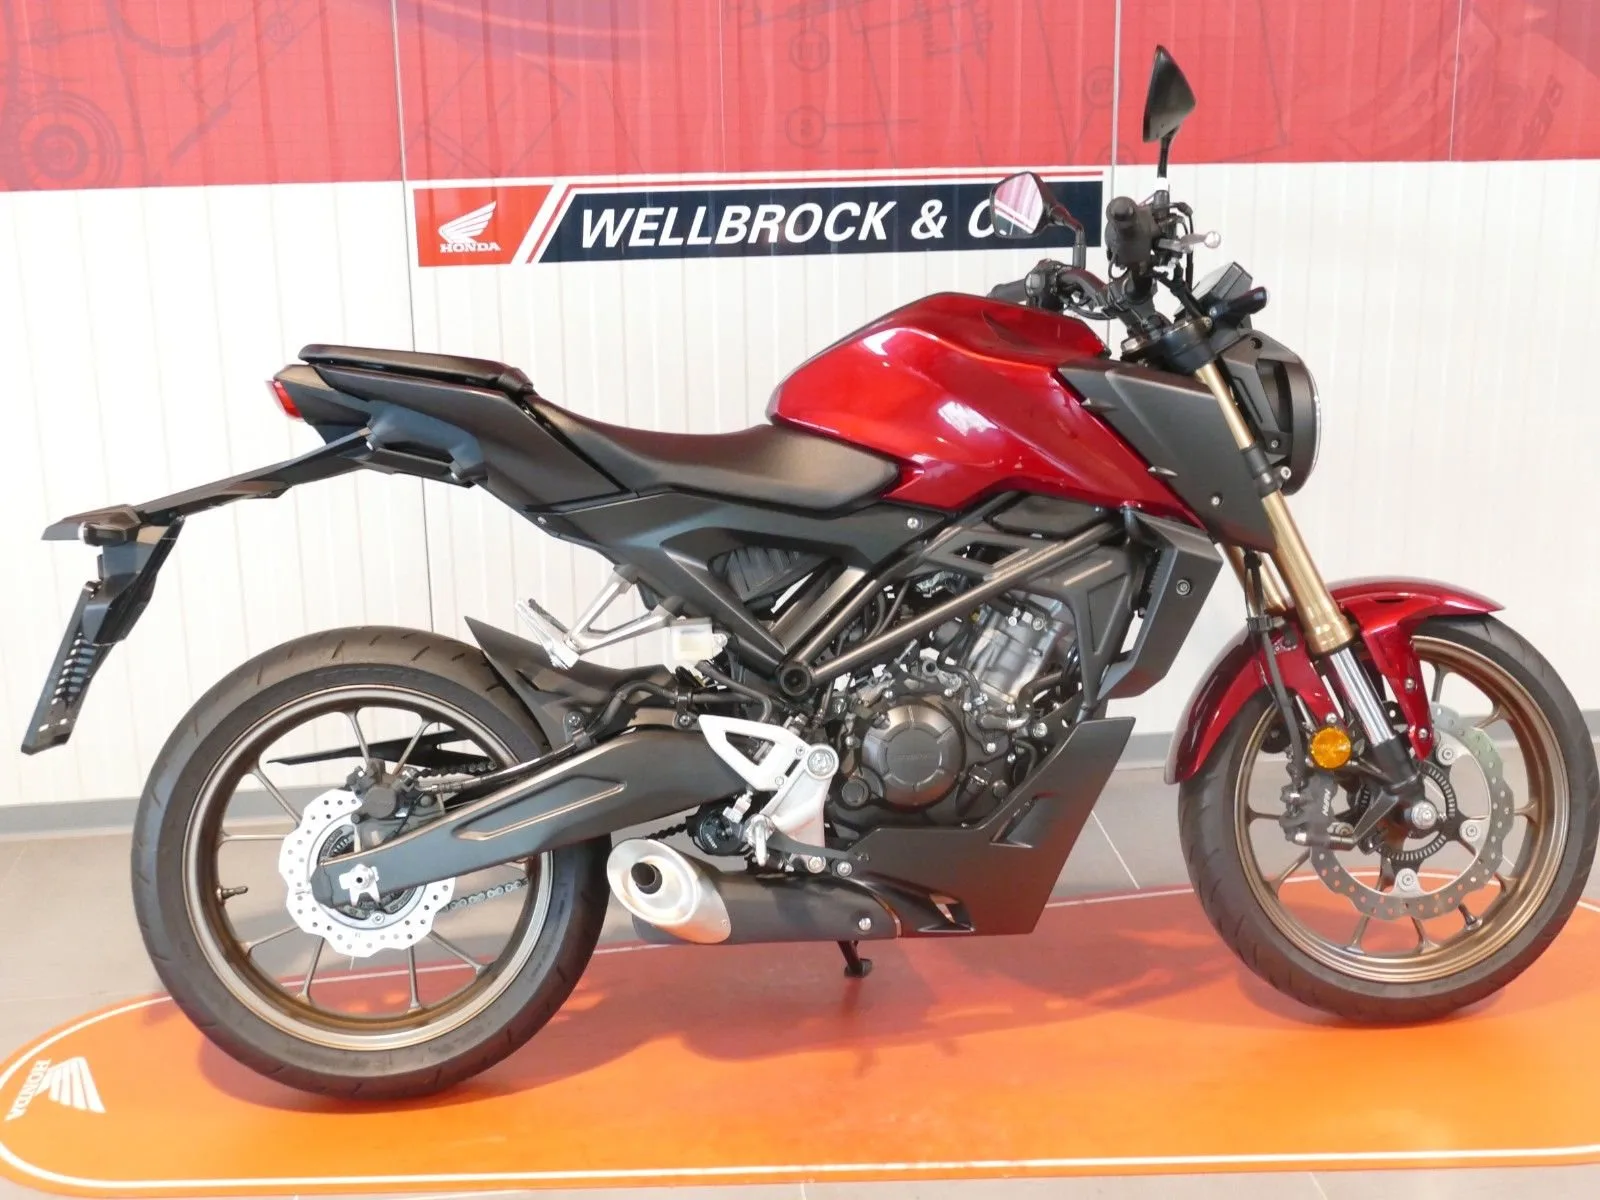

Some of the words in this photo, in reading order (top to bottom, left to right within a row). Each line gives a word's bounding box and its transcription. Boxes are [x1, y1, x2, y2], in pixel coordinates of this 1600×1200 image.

[581, 200, 898, 248] WELLBROCK
[911, 199, 948, 240] &
[968, 198, 996, 239] C
[439, 241, 502, 254] HONDA
